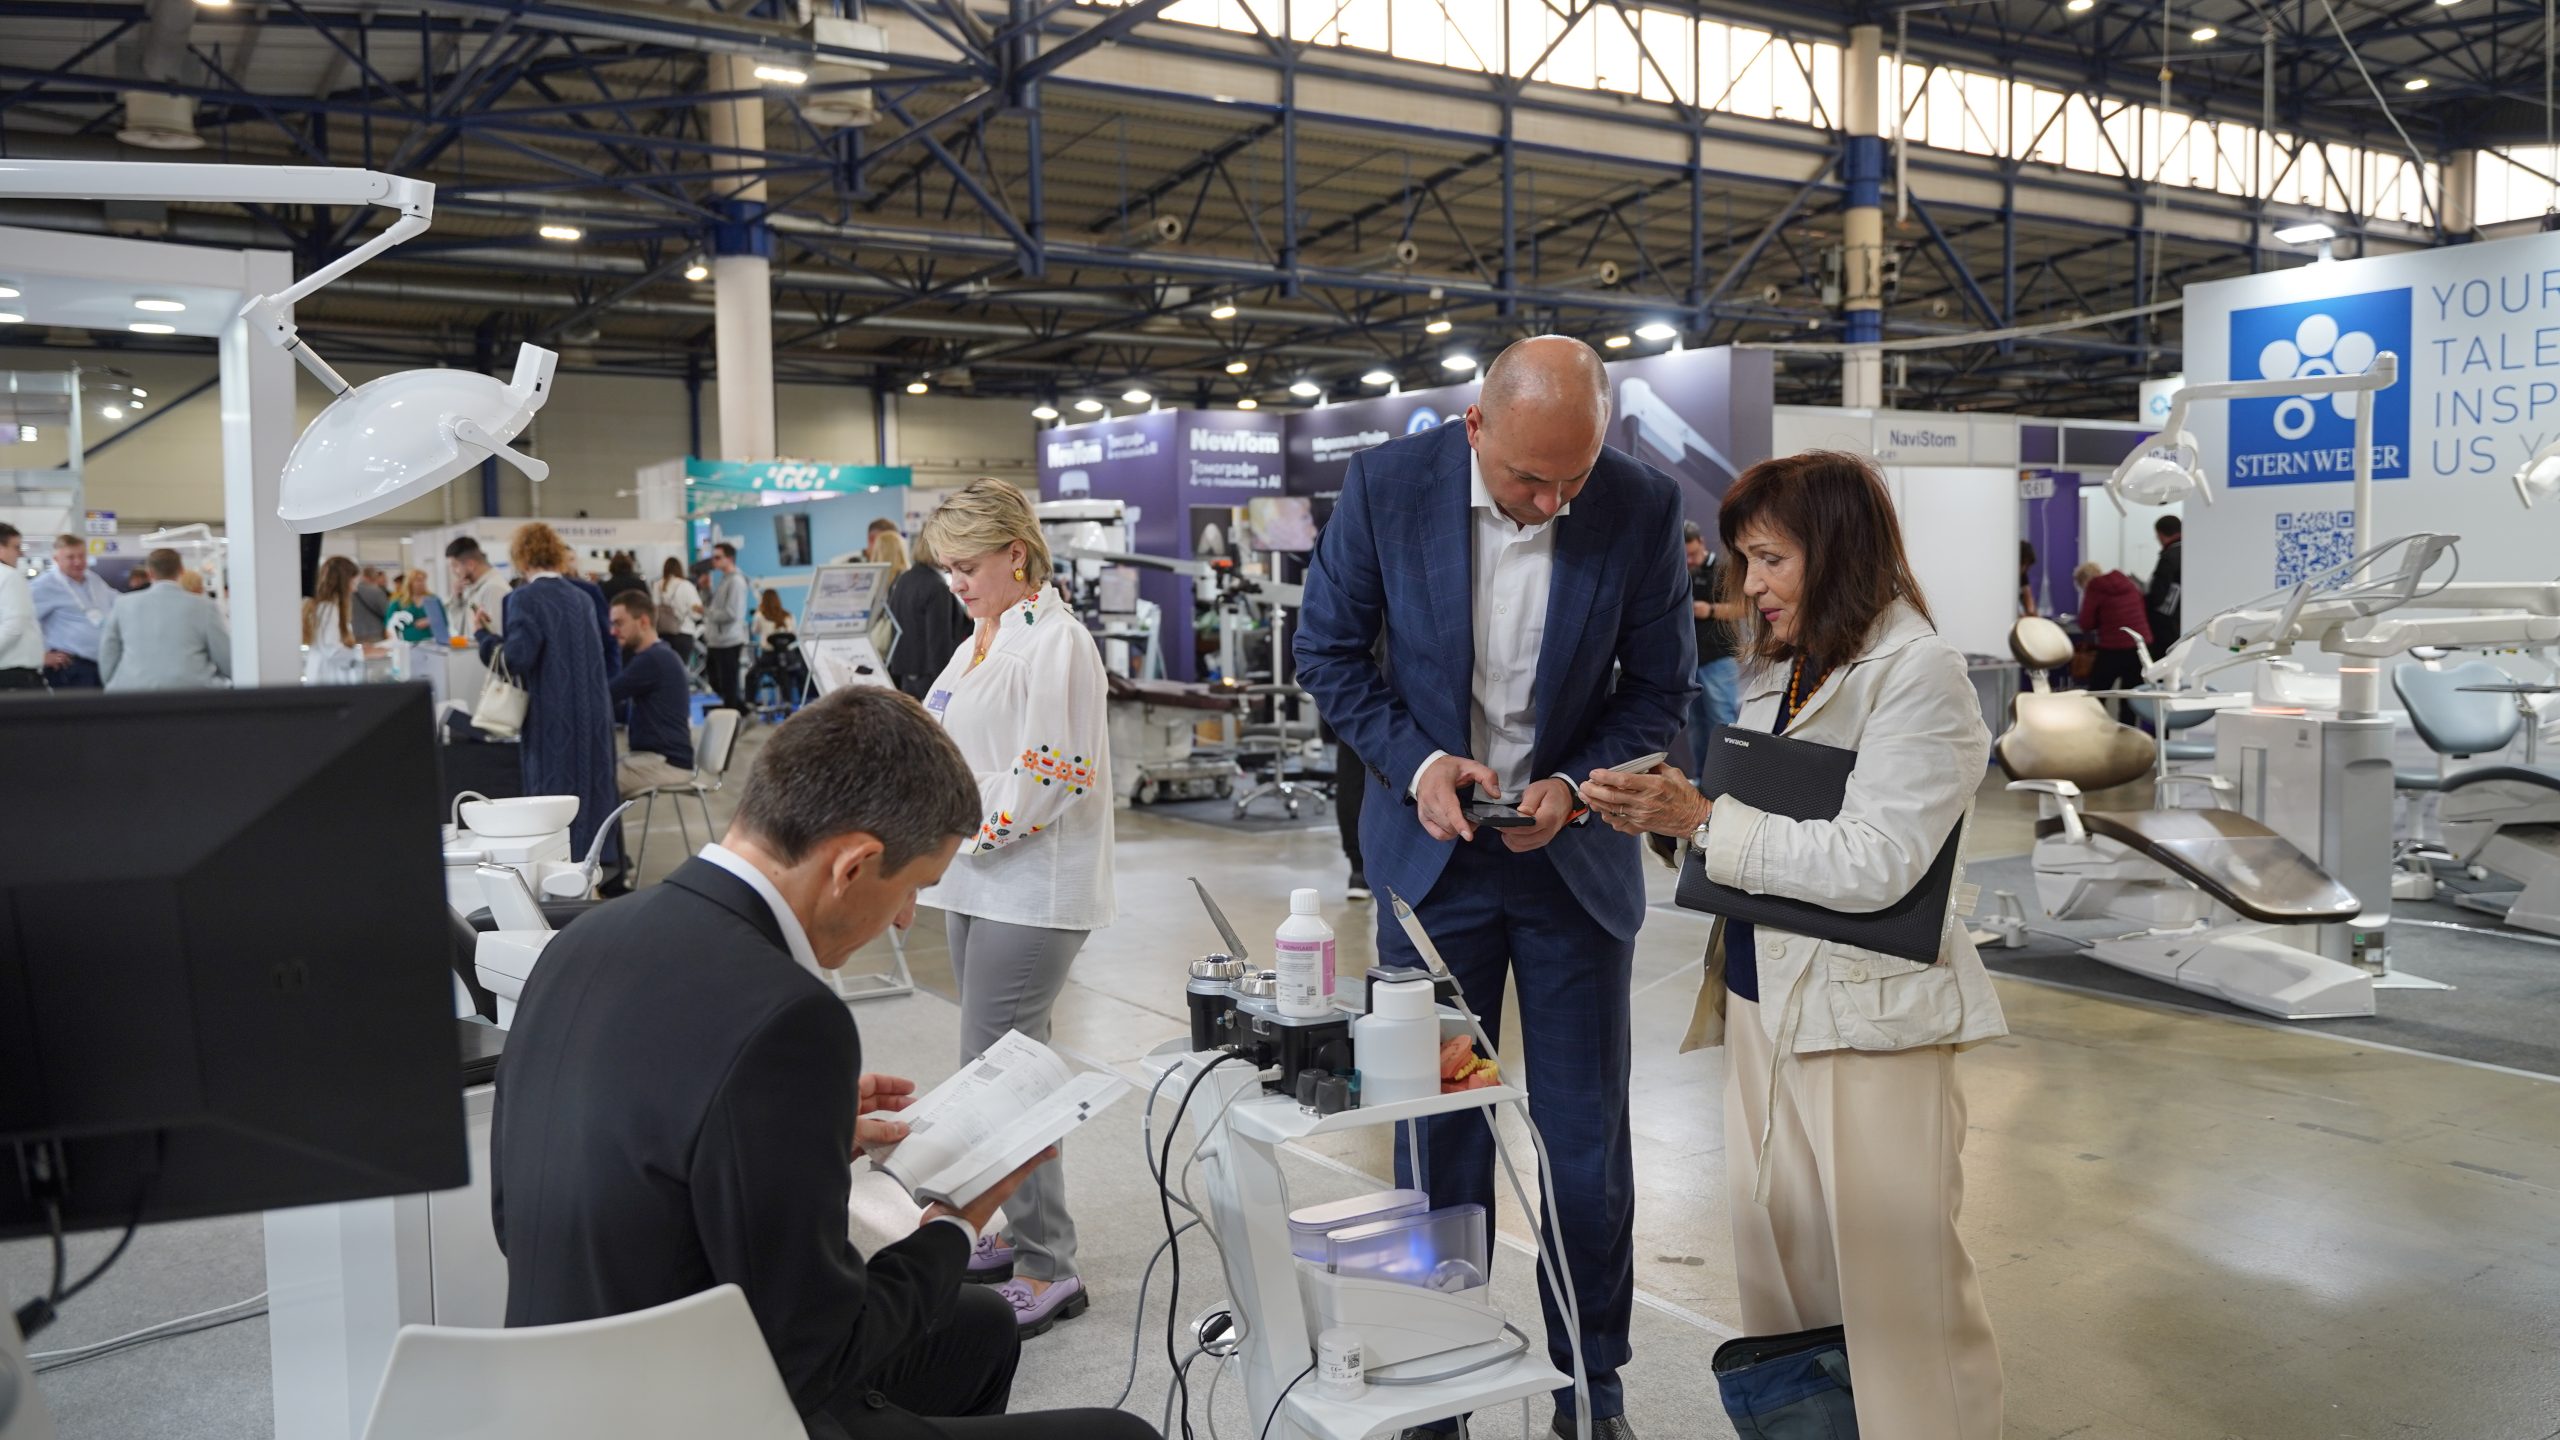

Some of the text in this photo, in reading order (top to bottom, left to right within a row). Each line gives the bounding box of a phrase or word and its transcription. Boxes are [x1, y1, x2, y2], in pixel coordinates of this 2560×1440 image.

[2431, 268, 2560, 321] YOUR
[2431, 326, 2560, 375] TALE
[2434, 382, 2558, 428] INSP
[1190, 428, 1280, 454] NewTom
[1889, 430, 1957, 448] NaviStom
[1189, 459, 1259, 478] Томографи
[2234, 445, 2400, 478] STERN WEER
[2433, 436, 2496, 476] US
[1724, 737, 1749, 747] NORMA
